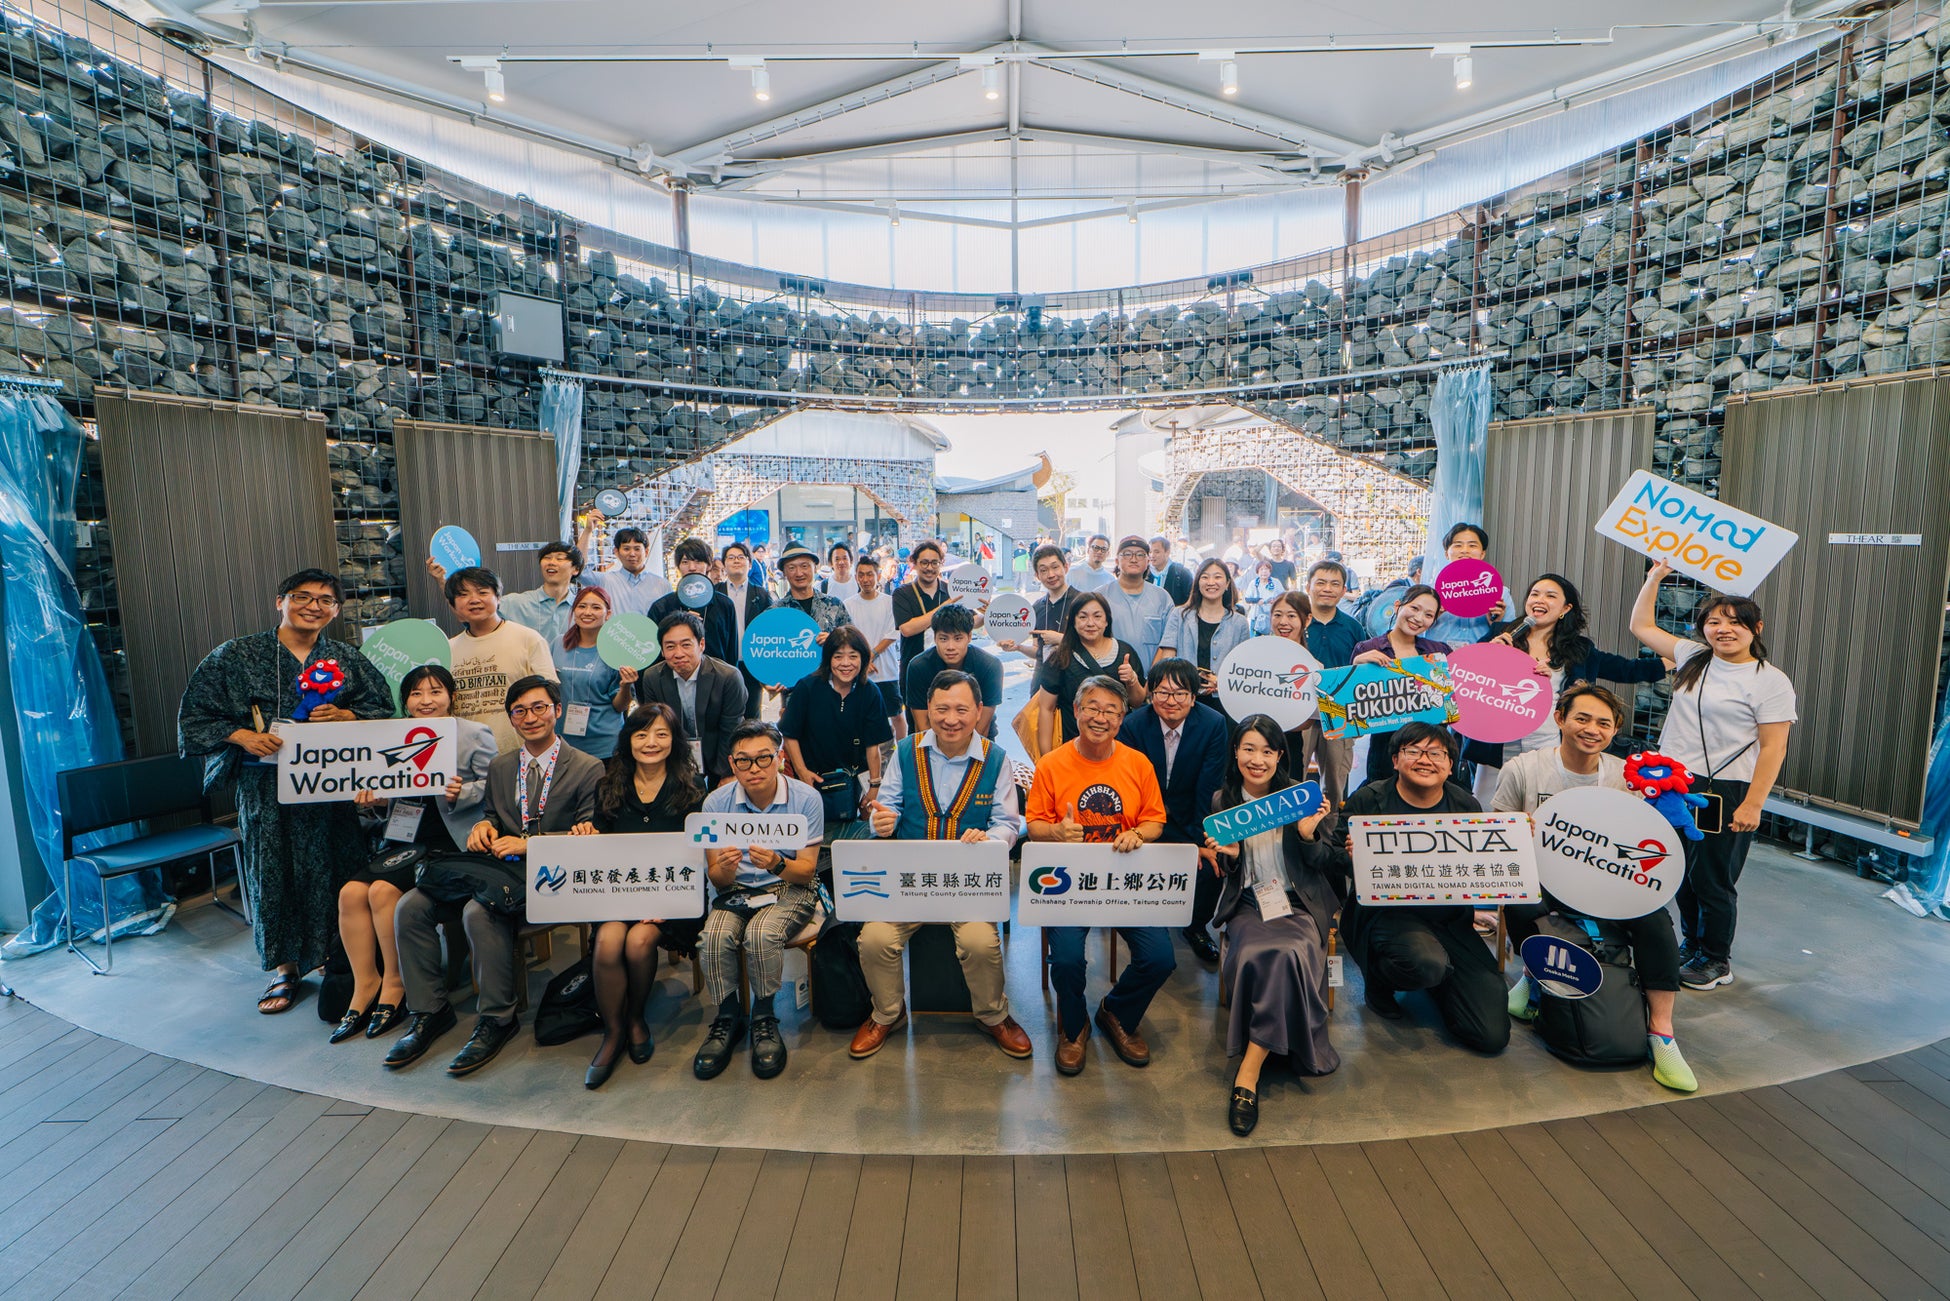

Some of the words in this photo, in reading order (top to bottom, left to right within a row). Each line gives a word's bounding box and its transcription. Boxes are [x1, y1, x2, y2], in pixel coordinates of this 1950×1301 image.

[1615, 505, 1743, 581] Explore
[952, 586, 989, 594] Workcation
[1441, 580, 1469, 590] Japan
[1441, 585, 1498, 599] Workcation
[613, 620, 636, 641] Japan
[750, 633, 785, 646] Japan
[372, 637, 410, 665] Japan
[606, 627, 647, 664] Workcation
[750, 646, 817, 658] Workcation
[1228, 662, 1272, 681] Japan
[1450, 663, 1497, 688] Japan
[468, 676, 506, 689] BIRIYANI
[1228, 678, 1311, 702] Workcation
[1355, 677, 1416, 701] COLIVE
[1347, 692, 1431, 720] FUKUOKA
[290, 743, 372, 769] Japan
[290, 767, 445, 795] Workcation
[1079, 785, 1122, 812] CHIHSHANG
[1213, 788, 1310, 833] NOMAD
[725, 822, 799, 837] NOMAD
[1230, 821, 1275, 840] TAIWAN
[1545, 812, 1609, 847] Japan
[1366, 829, 1518, 854] TDNA
[1370, 863, 1521, 879] 台灣數位遊牧者協會
[1541, 831, 1662, 892] Workcation
[572, 866, 696, 885] 國家發展委員會
[900, 872, 1003, 889] 臺東縣政府
[1078, 872, 1189, 892] 池上鄉公所
[1069, 899, 1102, 907] Township
